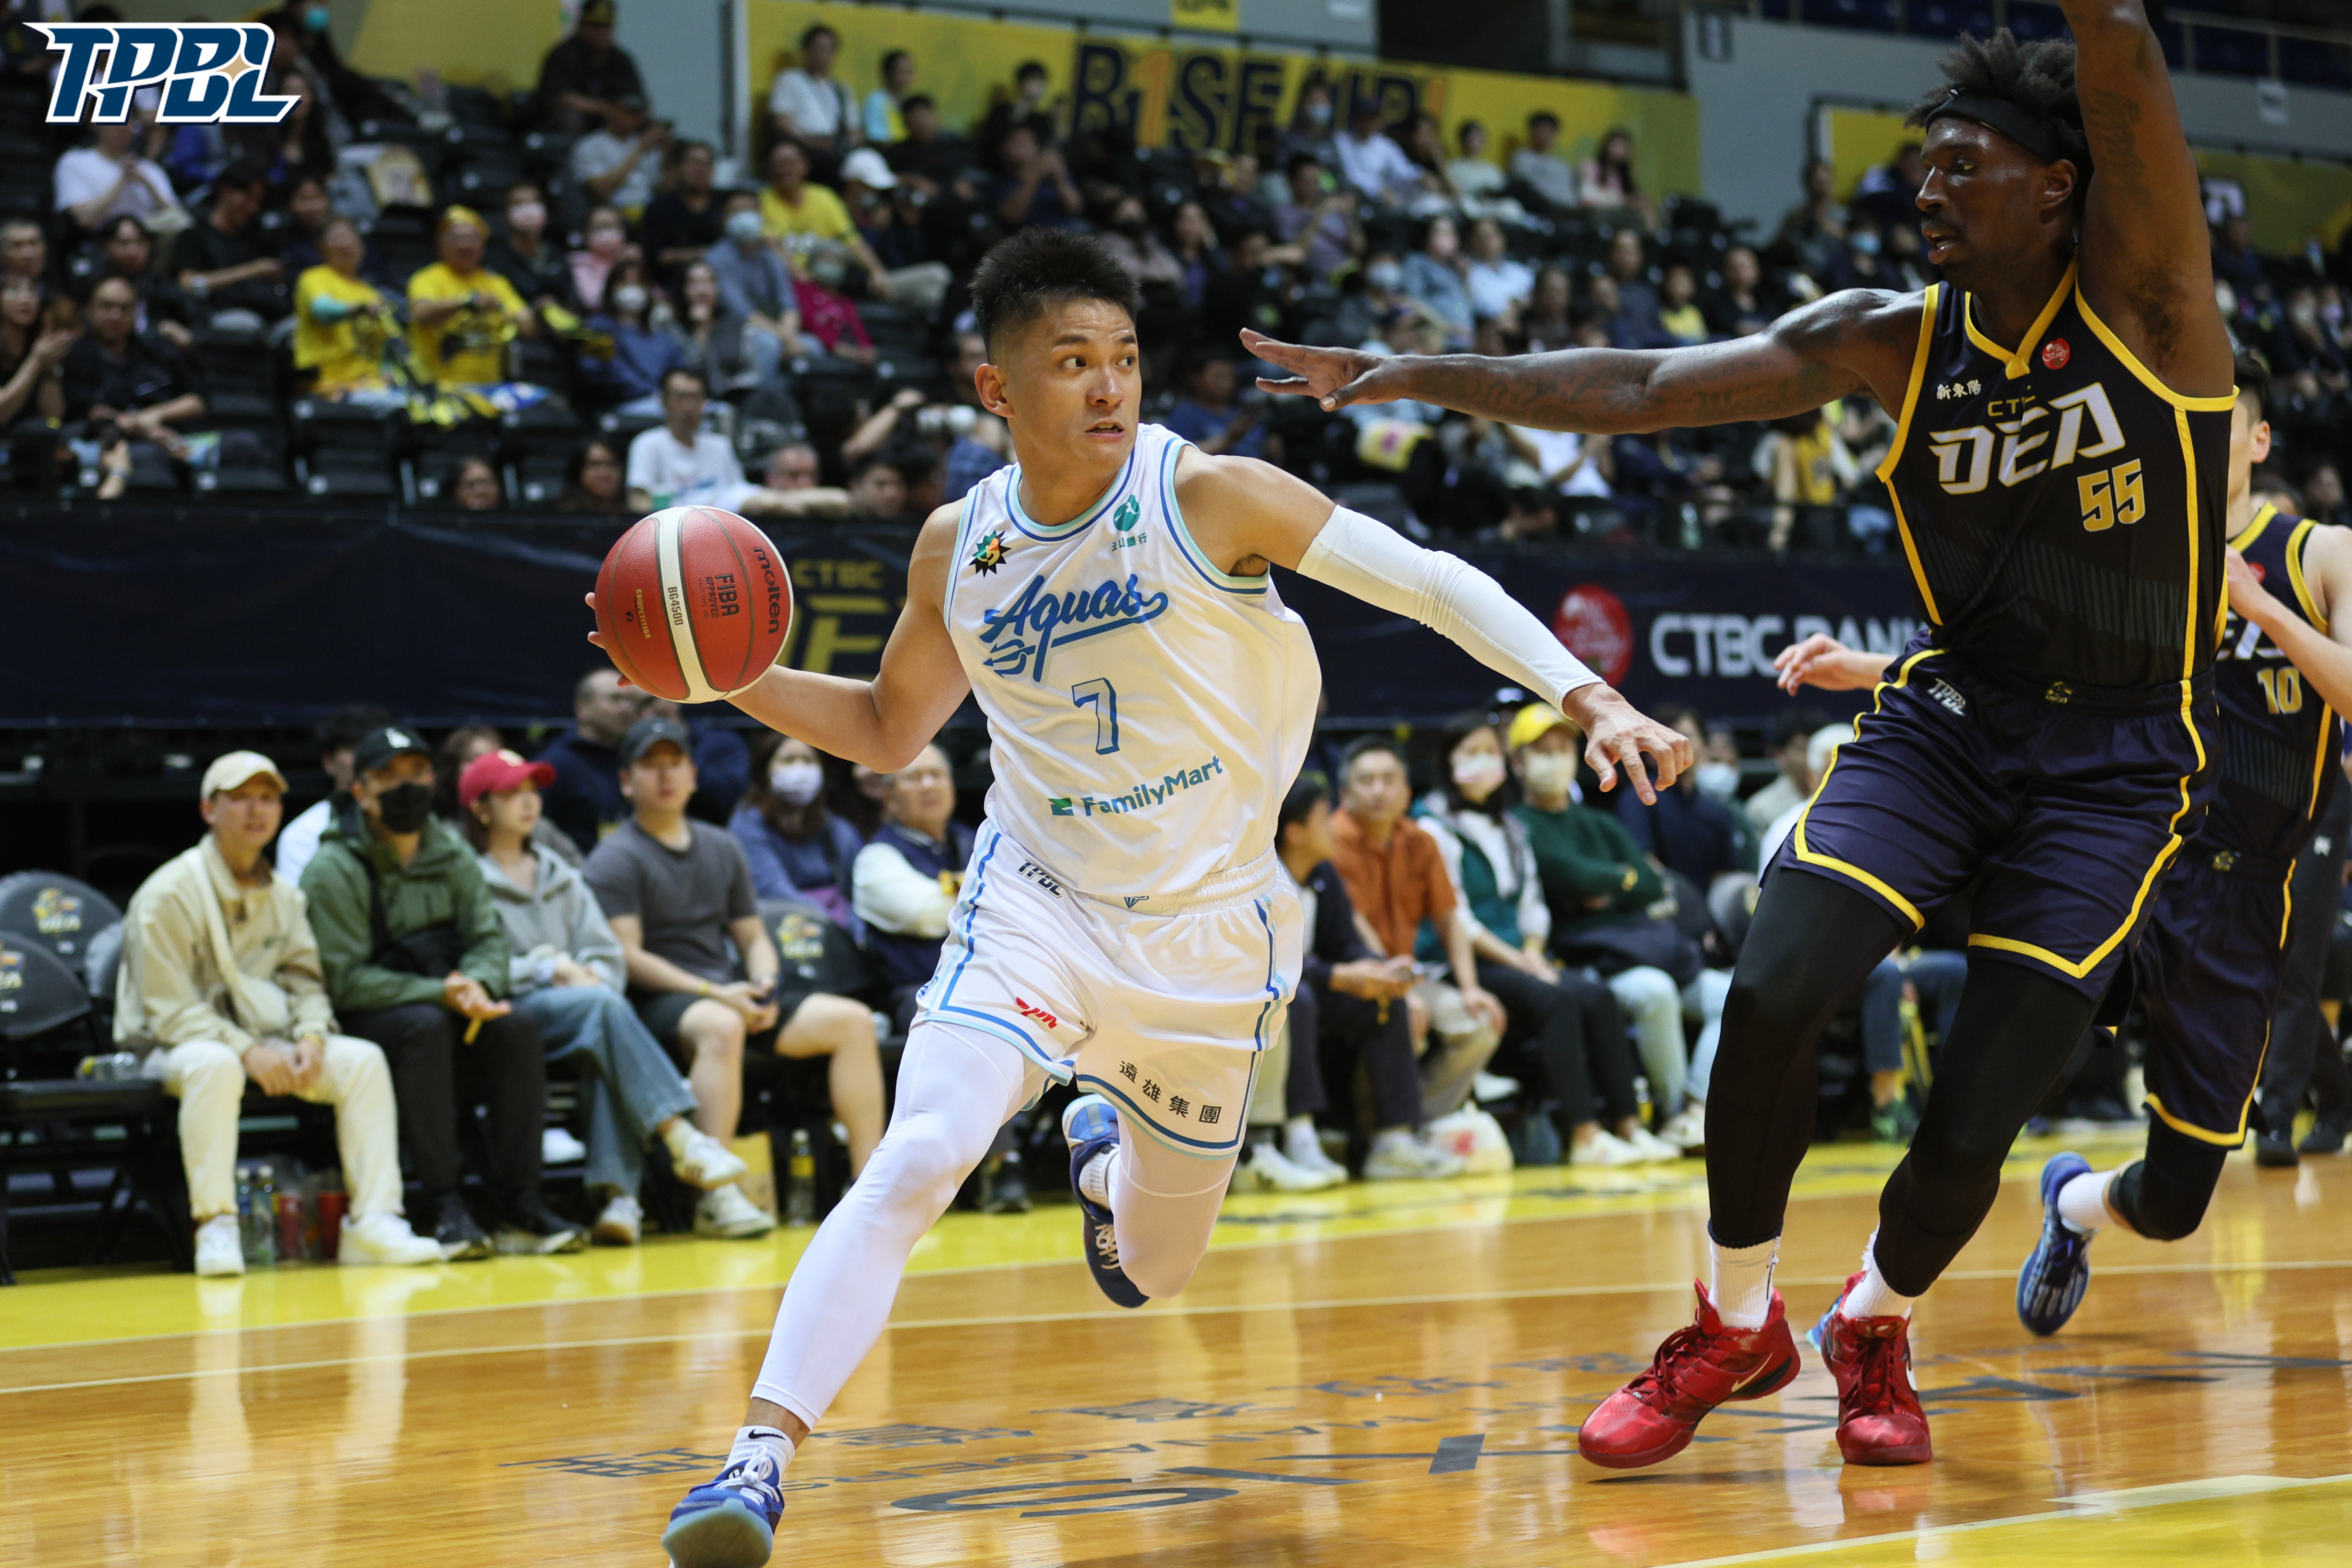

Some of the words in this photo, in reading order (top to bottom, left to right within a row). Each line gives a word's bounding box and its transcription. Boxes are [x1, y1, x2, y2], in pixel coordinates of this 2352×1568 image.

[1936, 379, 1982, 400] 新東陽
[1929, 382, 2126, 495] DEA
[2077, 458, 2145, 532] 55
[1111, 532, 1147, 552] 玉山銀行
[705, 576, 719, 618] APPROVED
[715, 573, 740, 617] FIBA
[753, 548, 781, 634] molten
[791, 557, 885, 590] CTBC
[636, 589, 651, 639] COMPETITION
[668, 586, 684, 626] BG4500
[979, 573, 1169, 683] Aquas
[1648, 612, 1785, 678] CTBC
[1927, 677, 1966, 716] TPBL
[2257, 667, 2302, 715] 10
[1071, 677, 1120, 755] 7
[1081, 755, 1223, 817] FamilyMart
[1016, 858, 1063, 898] TPBL
[1118, 1060, 1222, 1124] 遠雄集團
